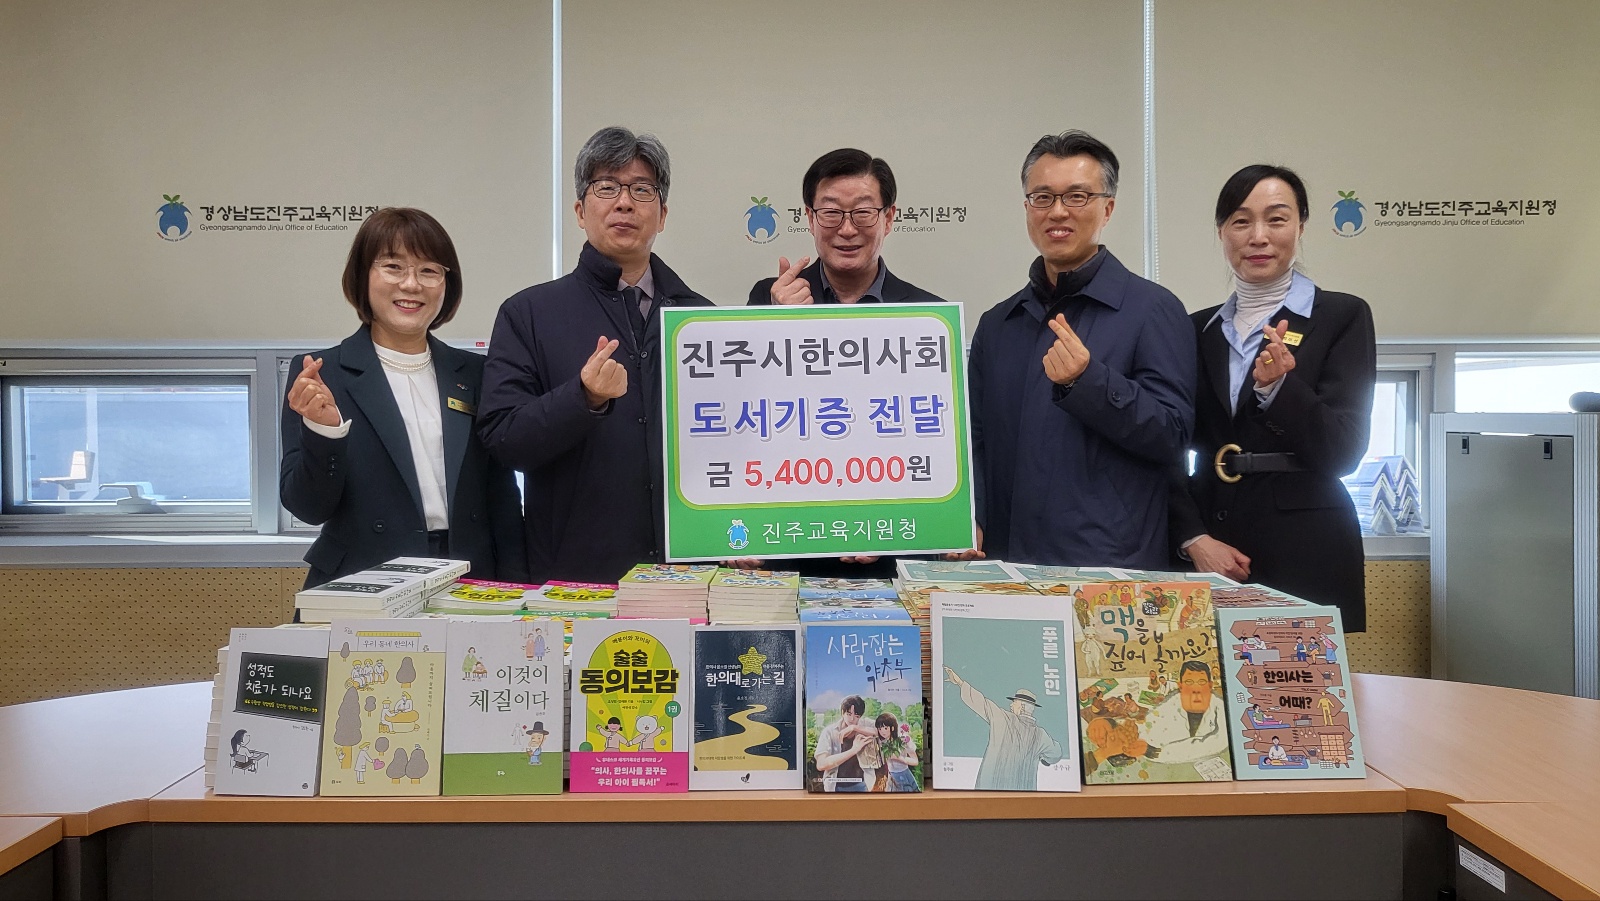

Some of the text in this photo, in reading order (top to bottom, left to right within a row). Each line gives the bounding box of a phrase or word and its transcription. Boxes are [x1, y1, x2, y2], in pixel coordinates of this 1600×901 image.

[1374, 200, 1557, 217] 경상남도진주교육지원청
[199, 223, 348, 233] Gyeongsangnamdo Jinju Office of Education
[1374, 218, 1525, 228] Gyeongsangnamdo Jinju Office of Education
[681, 335, 948, 379] 진주시한의사회
[689, 394, 945, 440] 도서기증 전달
[706, 456, 932, 490] 금 5,400,000원
[762, 518, 917, 545] 진주교육지원청
[1101, 605, 1149, 646] 맥을
[363, 640, 414, 648] 우리 동네 한의사
[1103, 631, 1211, 673] 짚어 볼까요?
[614, 649, 649, 668] 술술
[1042, 626, 1061, 696] 푸른 노인
[247, 663, 276, 679] 성적도
[496, 665, 548, 685] 이것이
[773, 671, 786, 686] 길
[865, 657, 913, 693] 약초부
[1263, 670, 1314, 684] 한의사는
[245, 680, 313, 700] 치료가 되나요
[580, 669, 680, 694] 동의보감
[469, 689, 550, 713] 체질이다
[667, 705, 678, 713] 1권
[1279, 696, 1313, 710] 어때?
[613, 766, 644, 776] 한의사를
[597, 777, 613, 787] 우리
[614, 777, 630, 787] 아이
